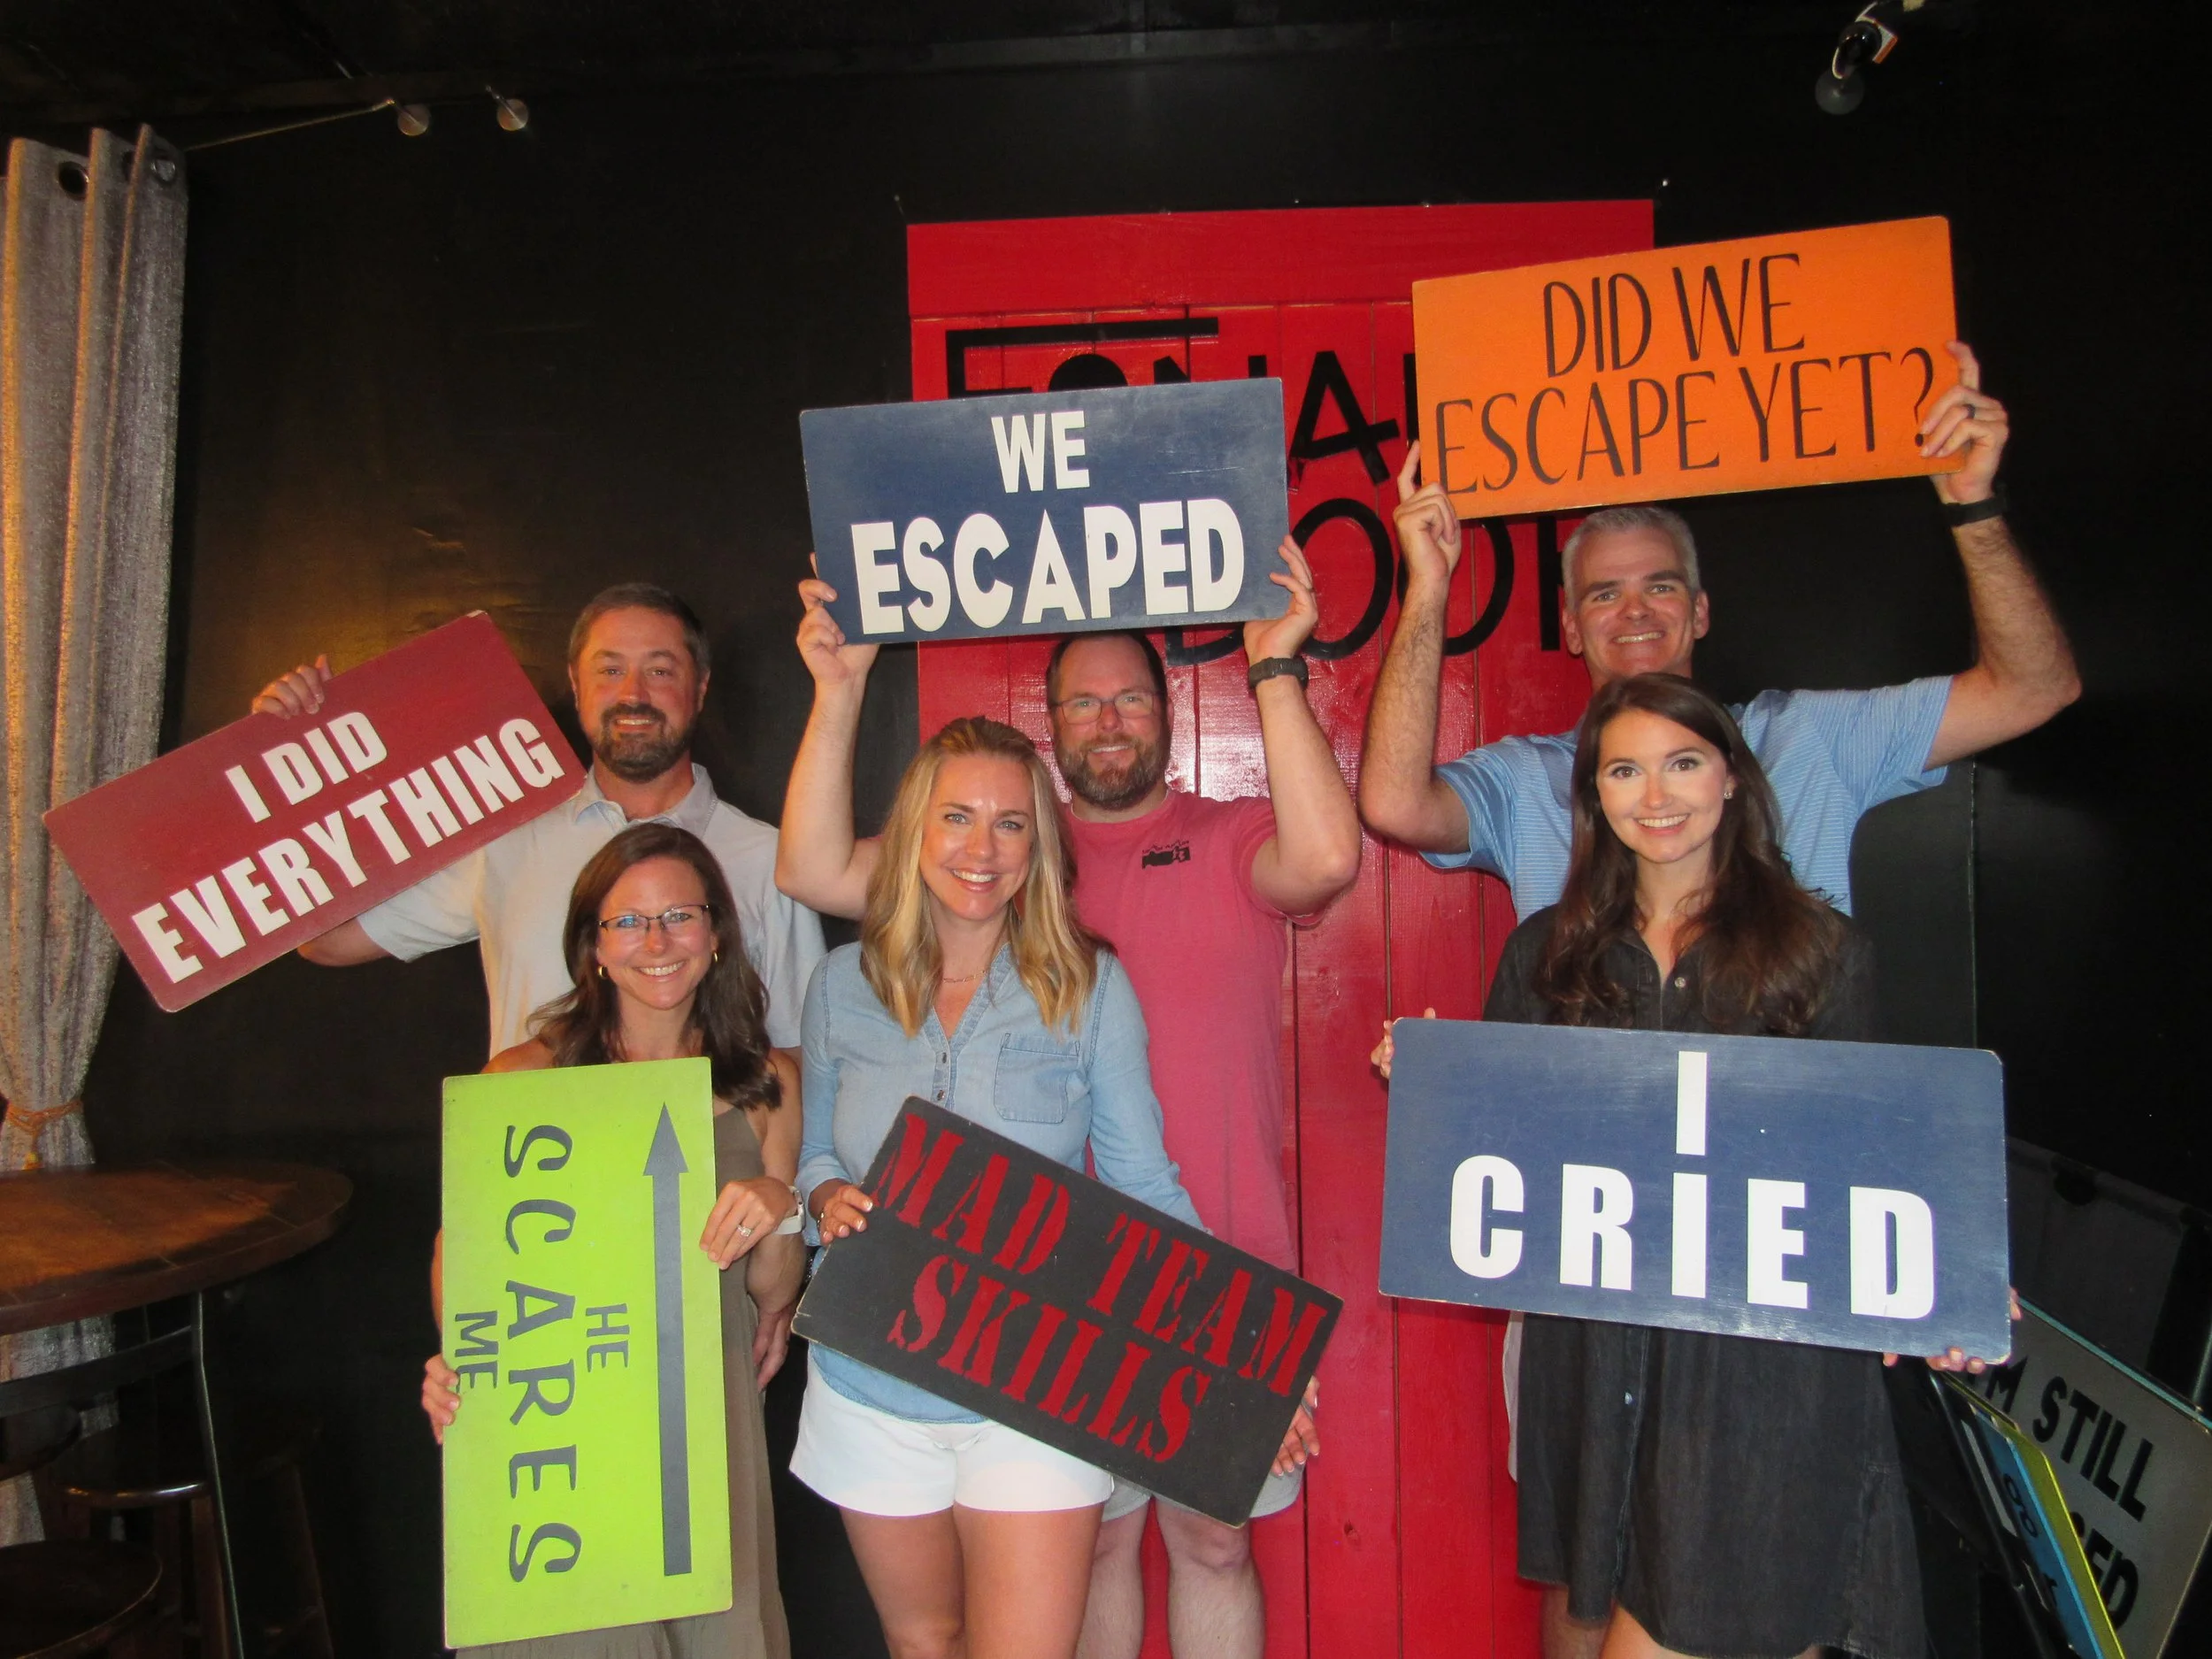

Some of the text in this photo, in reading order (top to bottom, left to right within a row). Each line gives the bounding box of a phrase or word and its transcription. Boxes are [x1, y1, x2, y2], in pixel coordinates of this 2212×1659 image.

[1542, 252, 1805, 379] DID WE
[991, 410, 1090, 494] WE
[1435, 369, 1720, 496] ESCAPE
[1738, 346, 1935, 465] YET?
[850, 498, 1245, 635] ESCAPED
[225, 710, 388, 824] I DID
[131, 718, 565, 984] EVERYTHING
[1675, 1050, 1709, 1156] I
[869, 1112, 1328, 1398] MAD TEAM
[1448, 1154, 1936, 1321] CRIED
[454, 1310, 499, 1394] ME
[503, 1124, 583, 1584] SCARES
[585, 1302, 631, 1373] HE
[887, 1254, 1213, 1463] SKILLS
[2032, 1375, 2154, 1522] STILL
